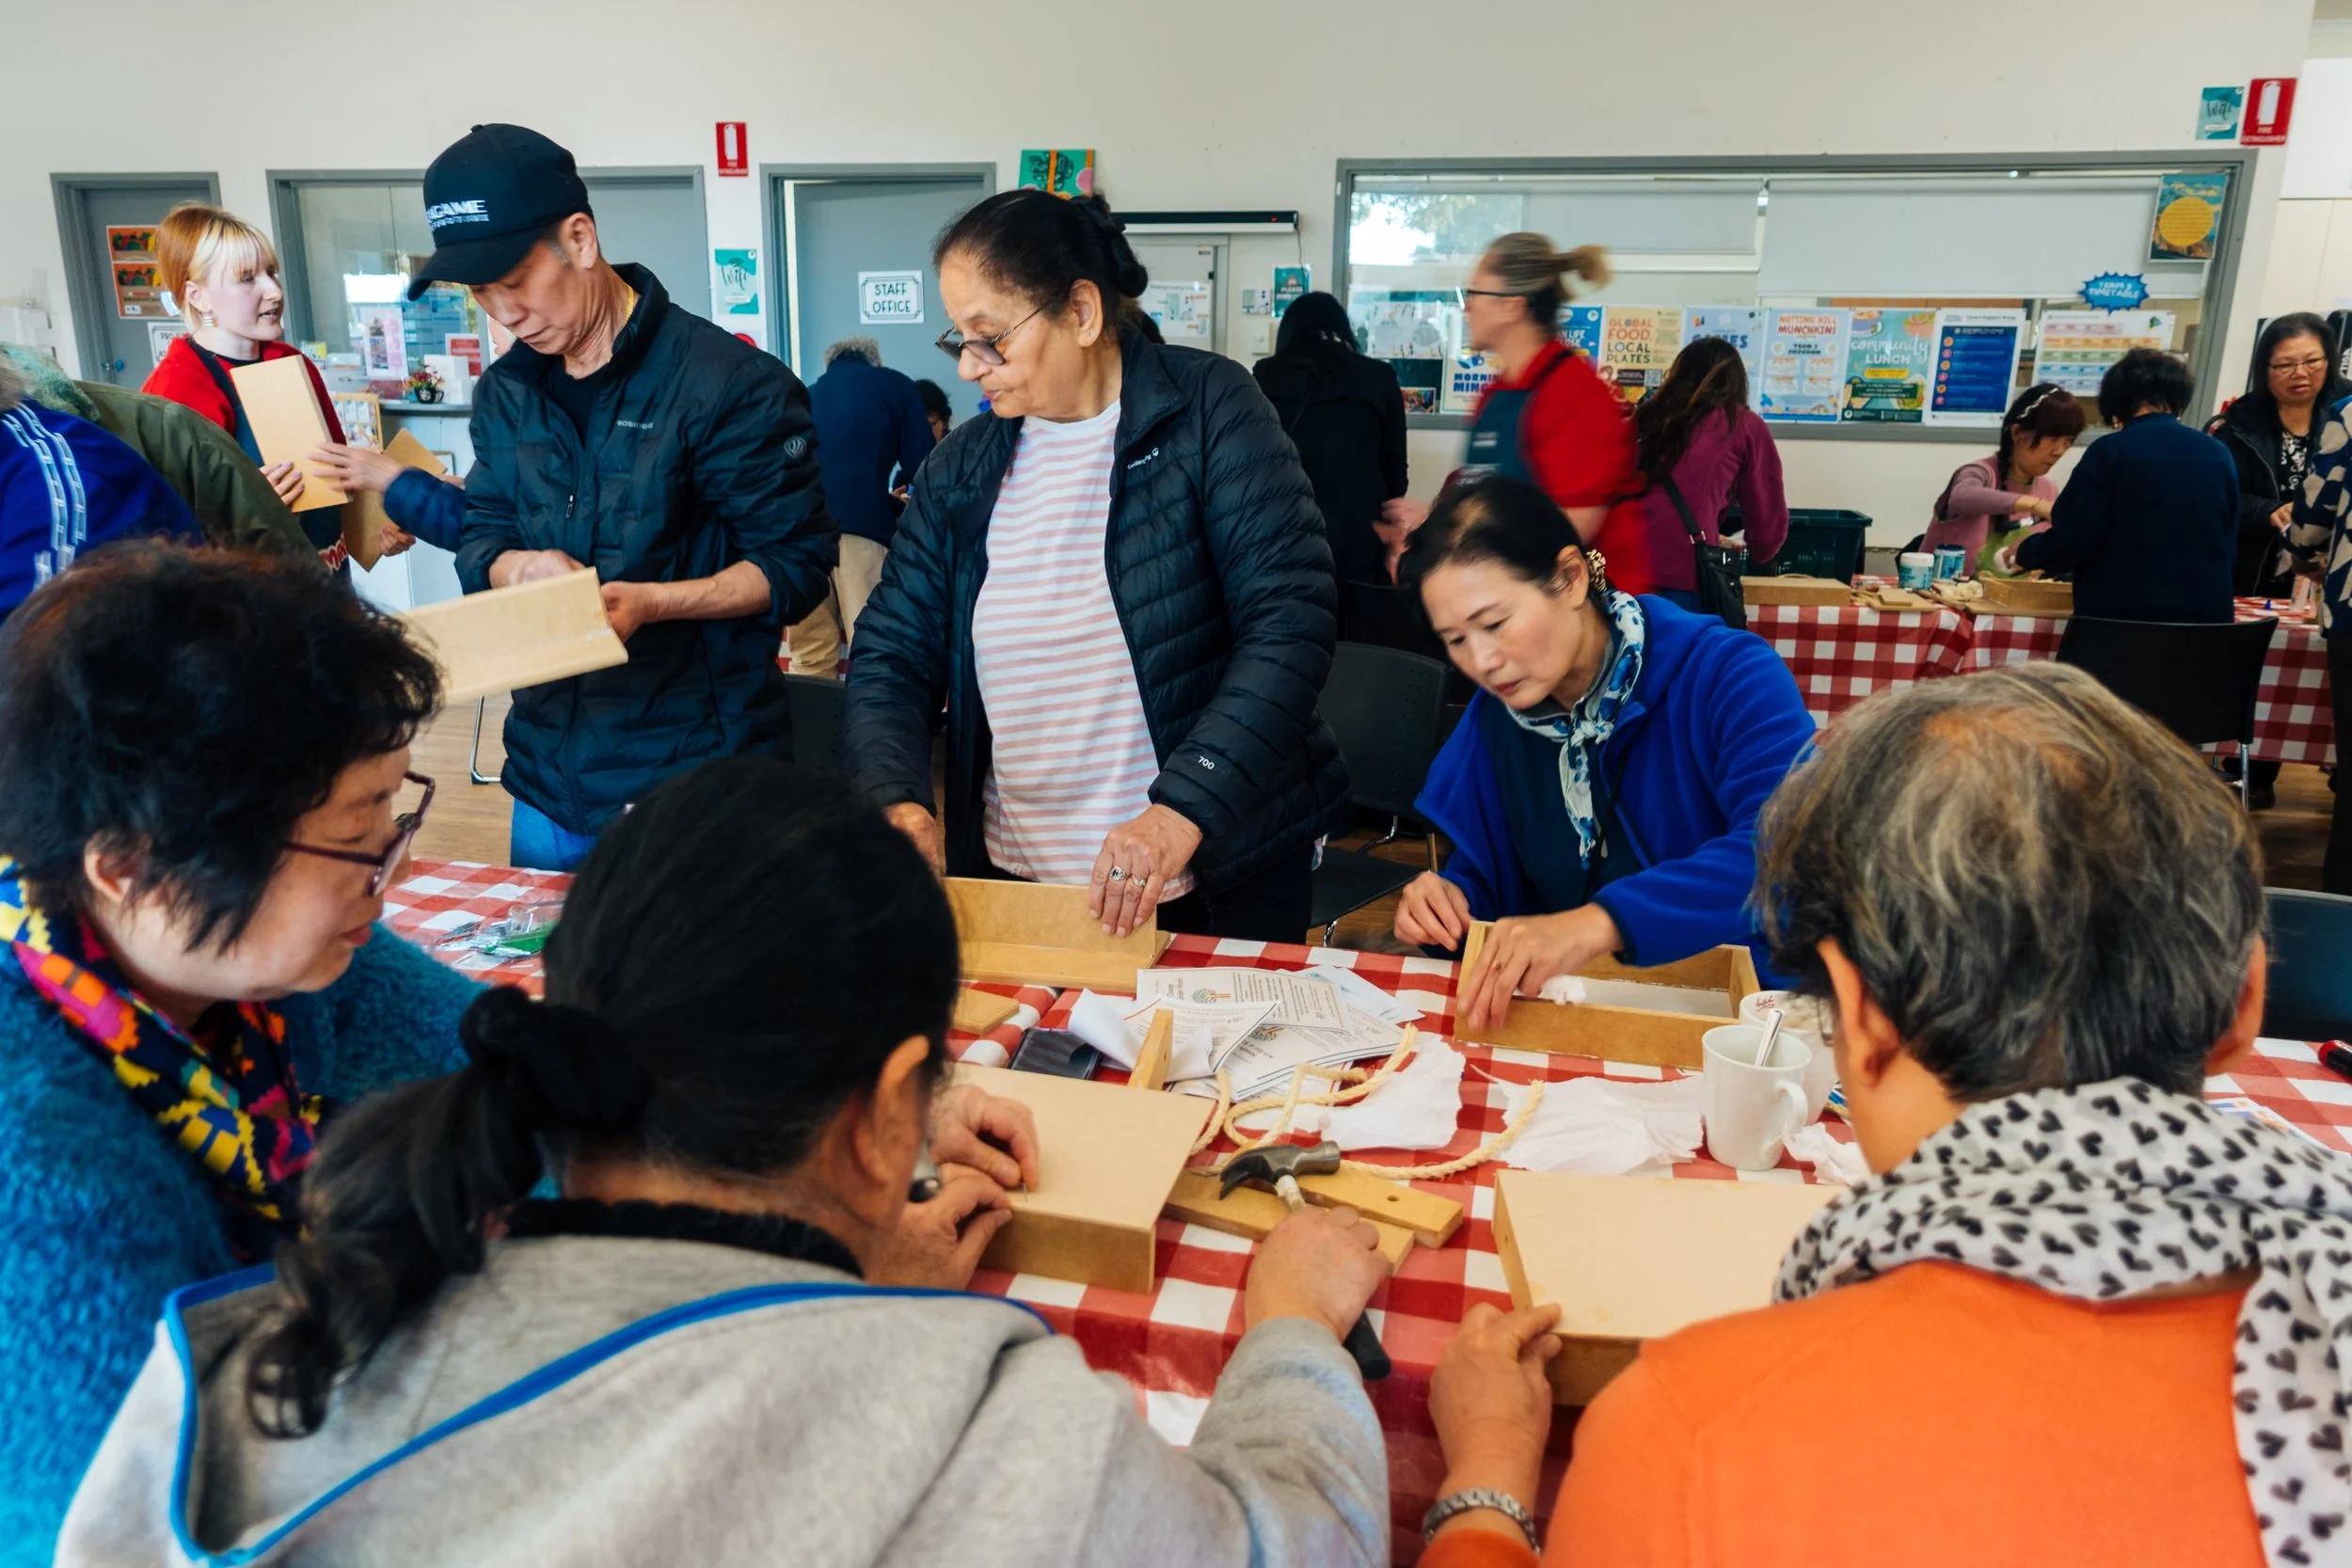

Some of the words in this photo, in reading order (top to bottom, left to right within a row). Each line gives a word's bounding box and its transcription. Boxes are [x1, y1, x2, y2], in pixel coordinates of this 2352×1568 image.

[874, 282, 908, 296] STAFF
[872, 299, 912, 313] OFFICE
[1609, 318, 1653, 327] GLOBAL
[1607, 328, 1651, 340] FOOD
[1777, 325, 1836, 336] MUNCHKINS
[1607, 342, 1651, 354] LOCAL
[1851, 333, 1928, 365] community
[1606, 354, 1651, 364] PLATES
[1865, 353, 1911, 365] LUNCH
[1198, 755, 1215, 769] 700
